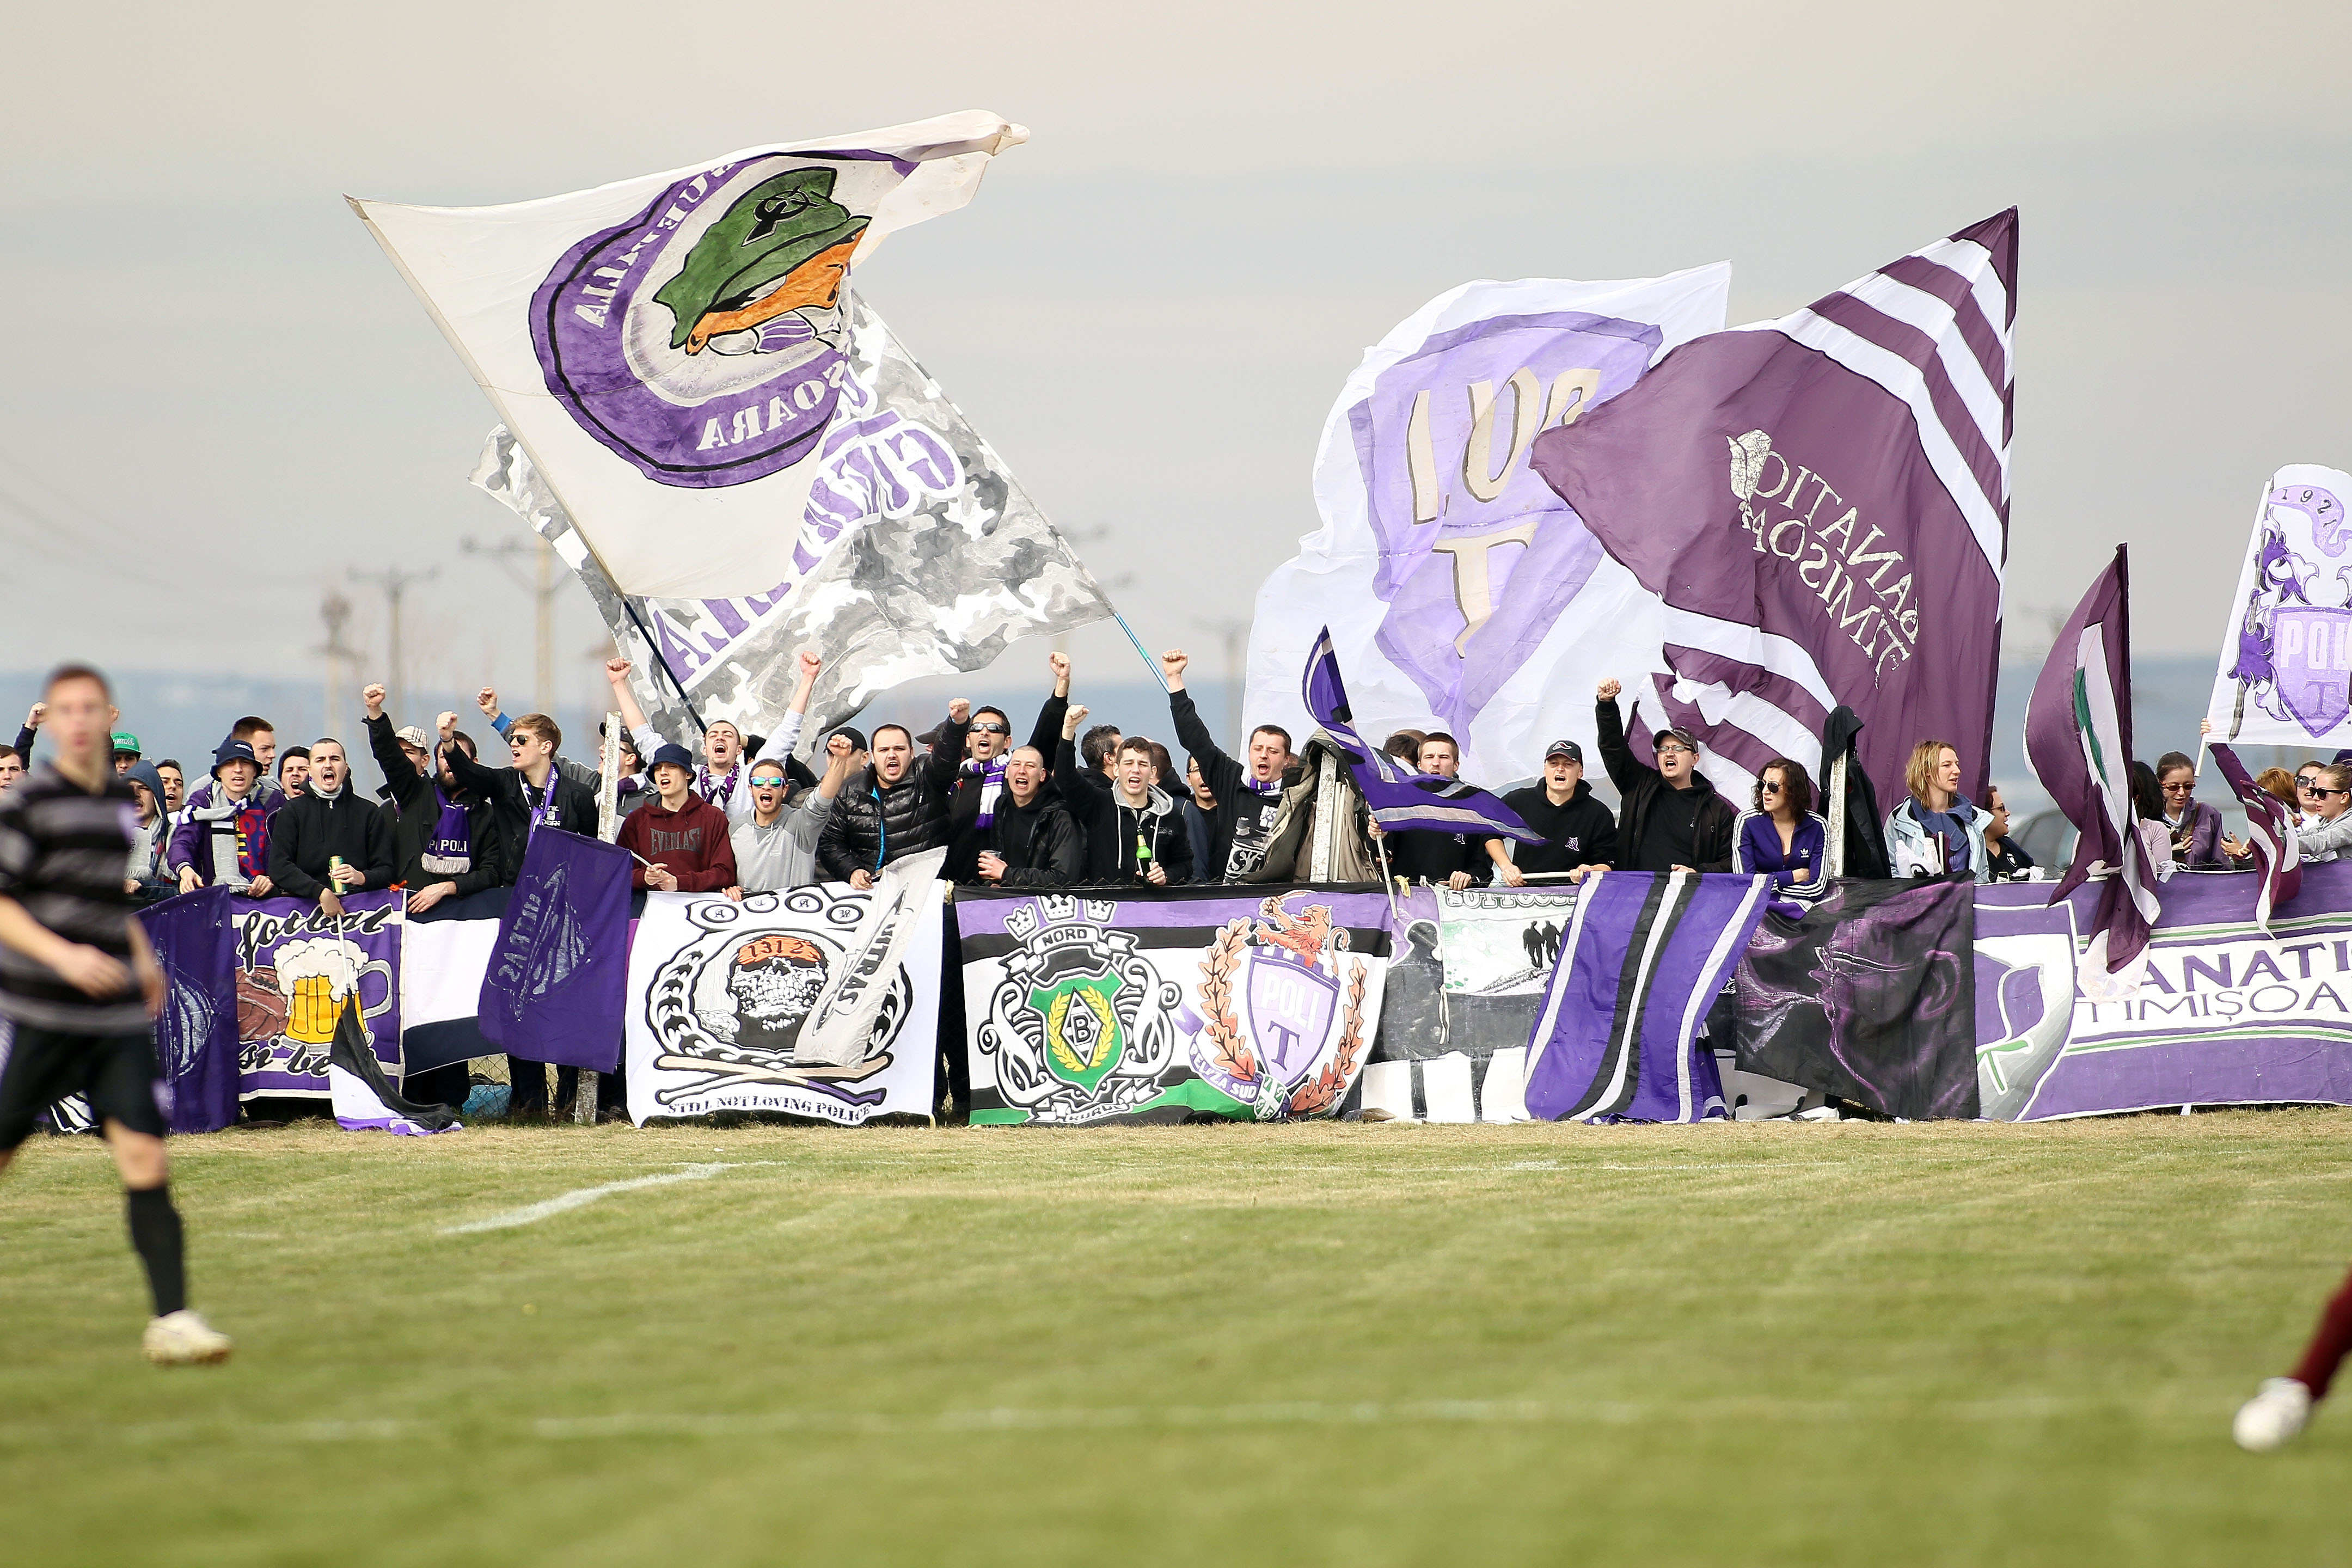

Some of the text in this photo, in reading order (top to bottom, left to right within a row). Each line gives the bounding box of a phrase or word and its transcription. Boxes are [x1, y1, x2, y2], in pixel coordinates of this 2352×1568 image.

[440, 839, 467, 852] POLI
[650, 826, 702, 855] EVERLAST
[748, 940, 804, 957] 1312
[1042, 928, 1088, 946] NORD
[2075, 940, 2352, 997] ANATI
[1260, 971, 1321, 1033] POLI
[1073, 1014, 1091, 1045] B
[1267, 1020, 1301, 1071] T
[1230, 1082, 1258, 1099] SUD
[668, 1095, 871, 1122] STILL NOT LOVING POLICE
